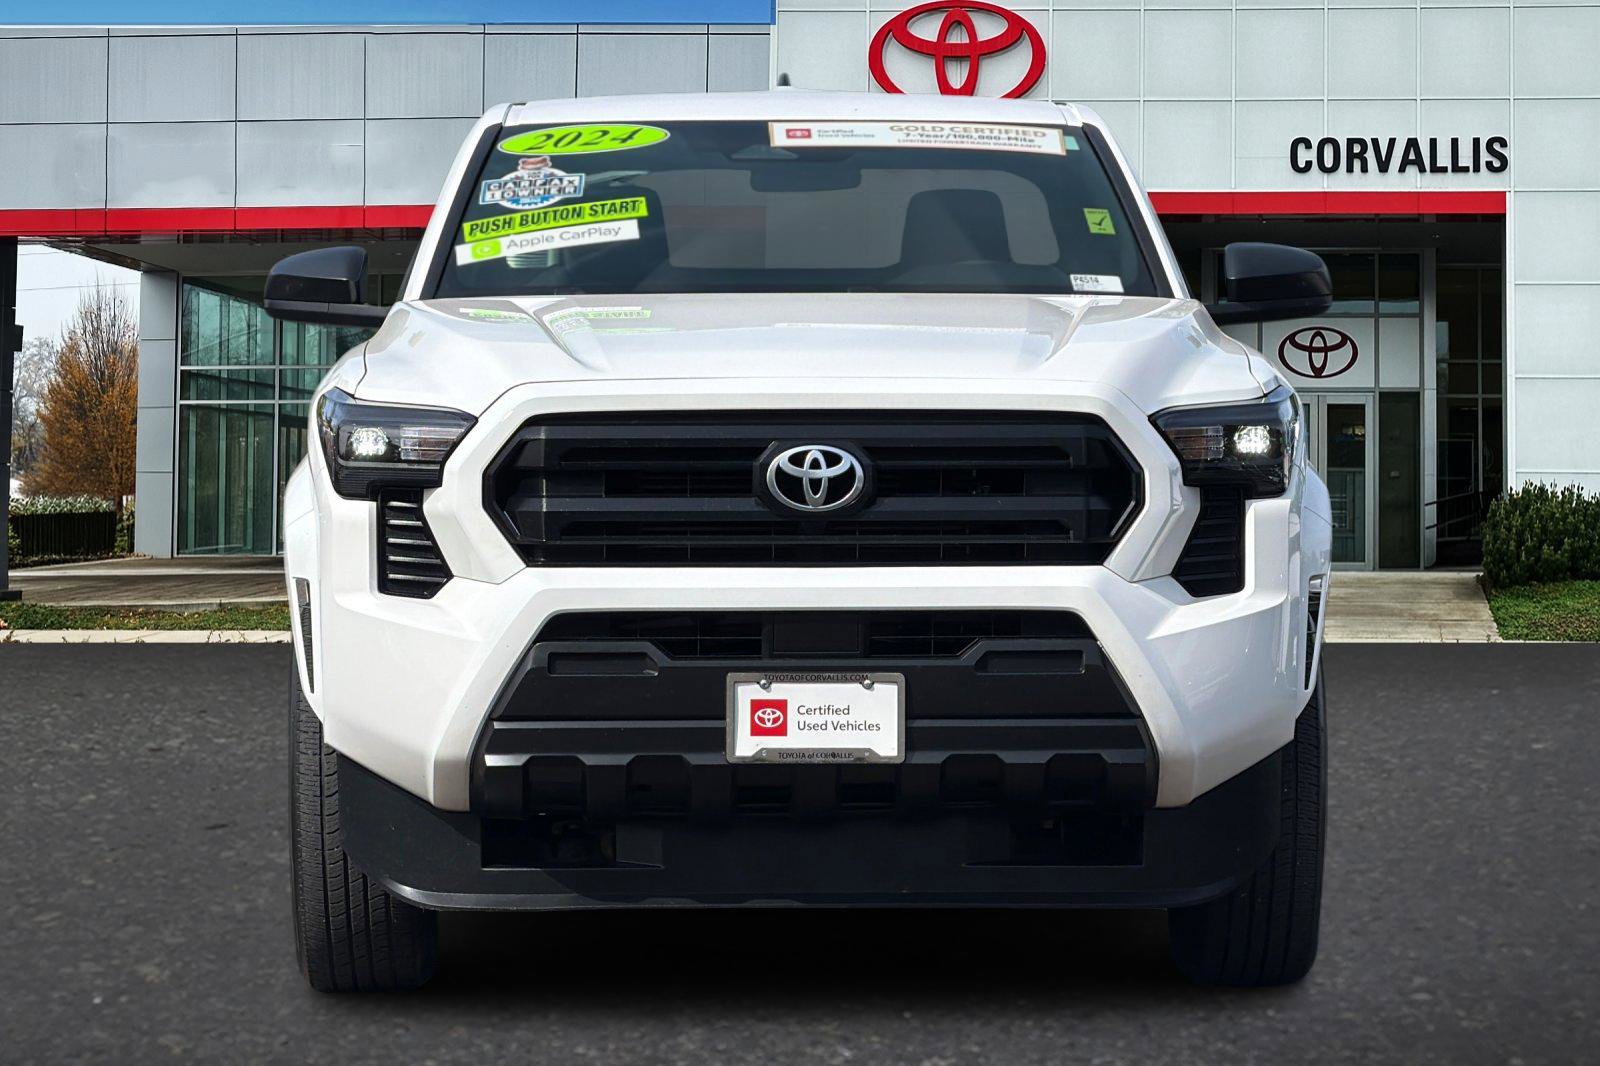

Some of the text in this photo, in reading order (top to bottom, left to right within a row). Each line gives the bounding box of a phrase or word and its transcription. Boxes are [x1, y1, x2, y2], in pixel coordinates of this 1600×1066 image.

[522, 127, 643, 151] 2024
[889, 125, 1046, 138] GOLD CERTIFIED
[1289, 136, 1509, 174] CORVALLIS
[468, 200, 641, 237] PUSH BUTTON START
[506, 225, 622, 250] Apple CarPlay
[797, 704, 850, 716] Certified
[797, 720, 881, 732] Used Vehicles
[778, 751, 807, 760] TOYOTA
